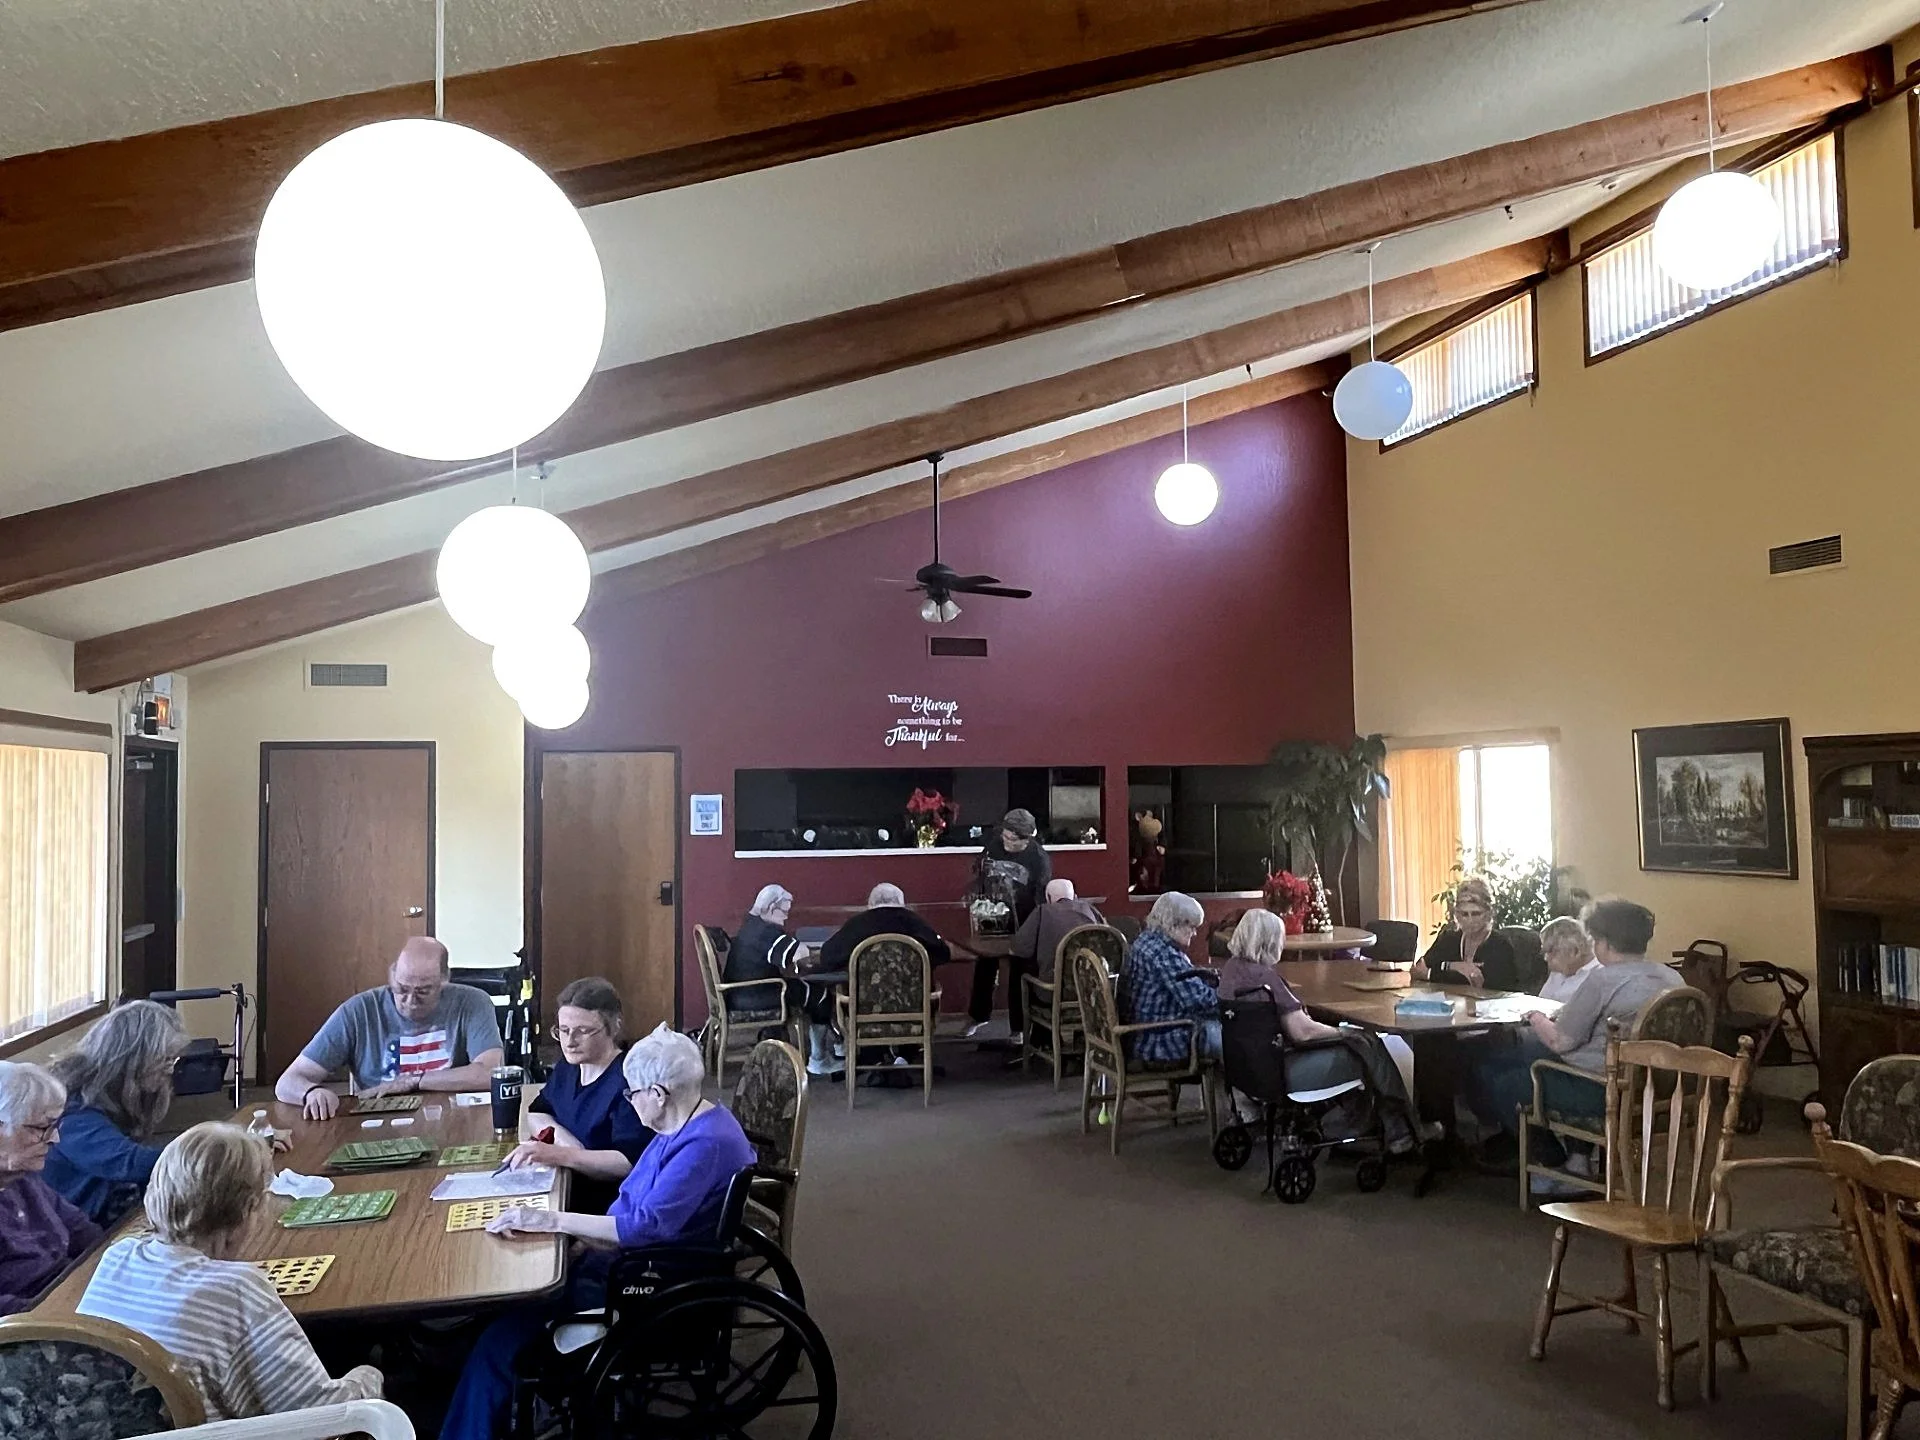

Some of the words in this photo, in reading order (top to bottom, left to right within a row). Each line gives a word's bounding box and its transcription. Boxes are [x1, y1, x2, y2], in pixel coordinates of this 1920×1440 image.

[888, 694, 913, 703] There
[911, 696, 958, 718] Always
[897, 717, 941, 726] something
[952, 716, 963, 725] be
[885, 726, 942, 750] Thankful
